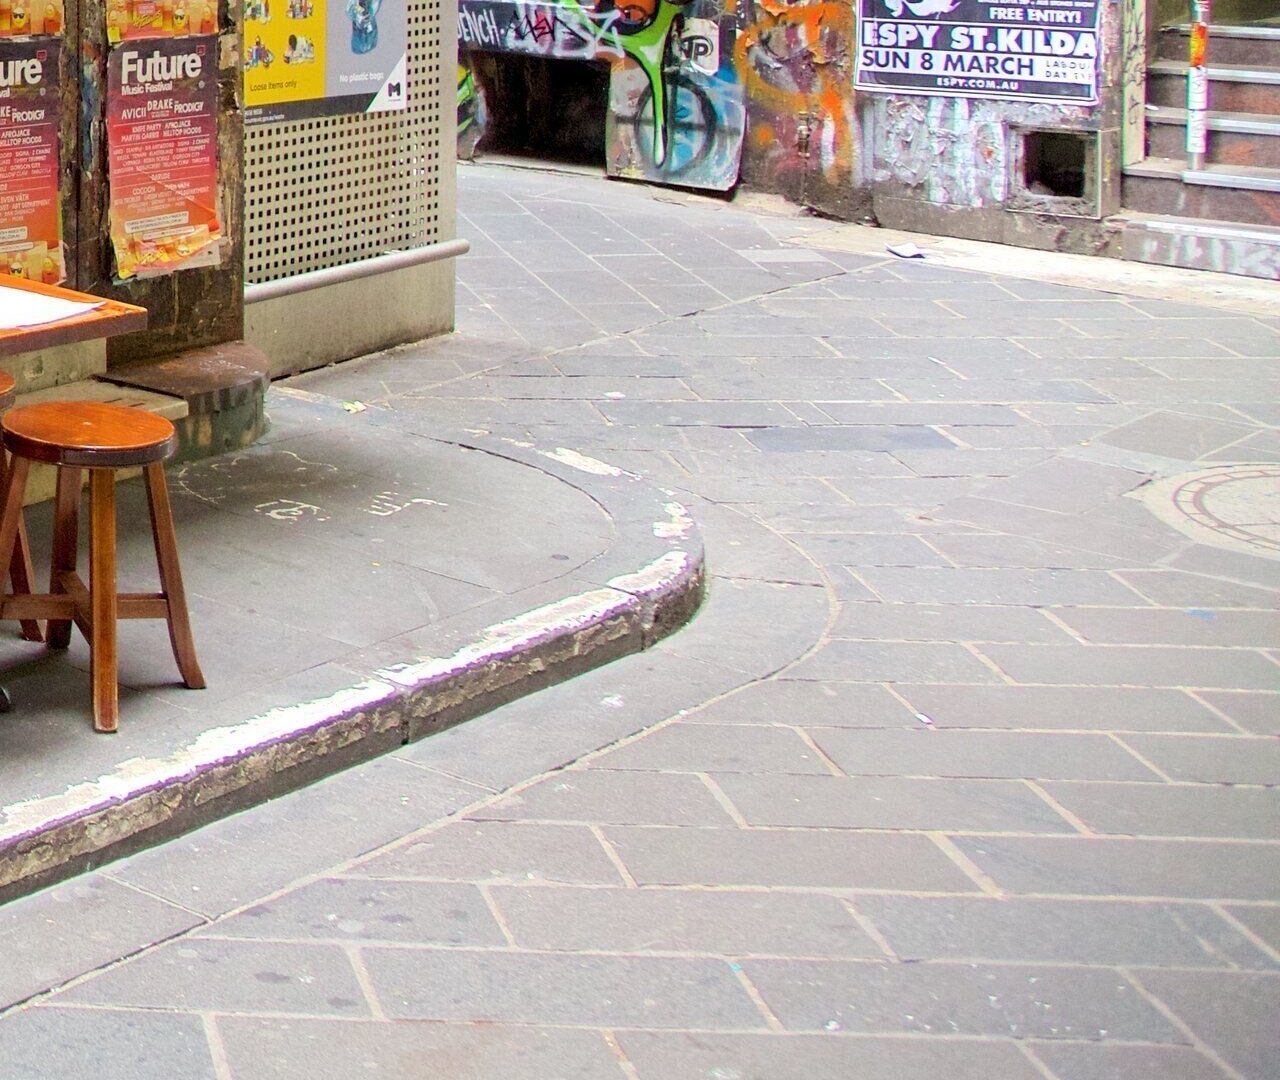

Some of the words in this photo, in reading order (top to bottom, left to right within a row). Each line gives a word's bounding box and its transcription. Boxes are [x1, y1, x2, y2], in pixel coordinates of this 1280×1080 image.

[990, 7, 1026, 20] FREE
[1028, 8, 1081, 23] ENTRY!
[863, 23, 940, 47] ESPY
[950, 26, 1097, 57] ST.KILDA
[862, 50, 910, 68] SUN
[921, 54, 933, 70] 8
[944, 54, 1034, 76] MARCH
[340, 73, 348, 81] No
[349, 72, 369, 83] plastic
[370, 72, 384, 81] bags
[937, 78, 1018, 90] ESPY.COM.AU
[250, 83, 267, 91] Loose
[285, 80, 297, 88] only
